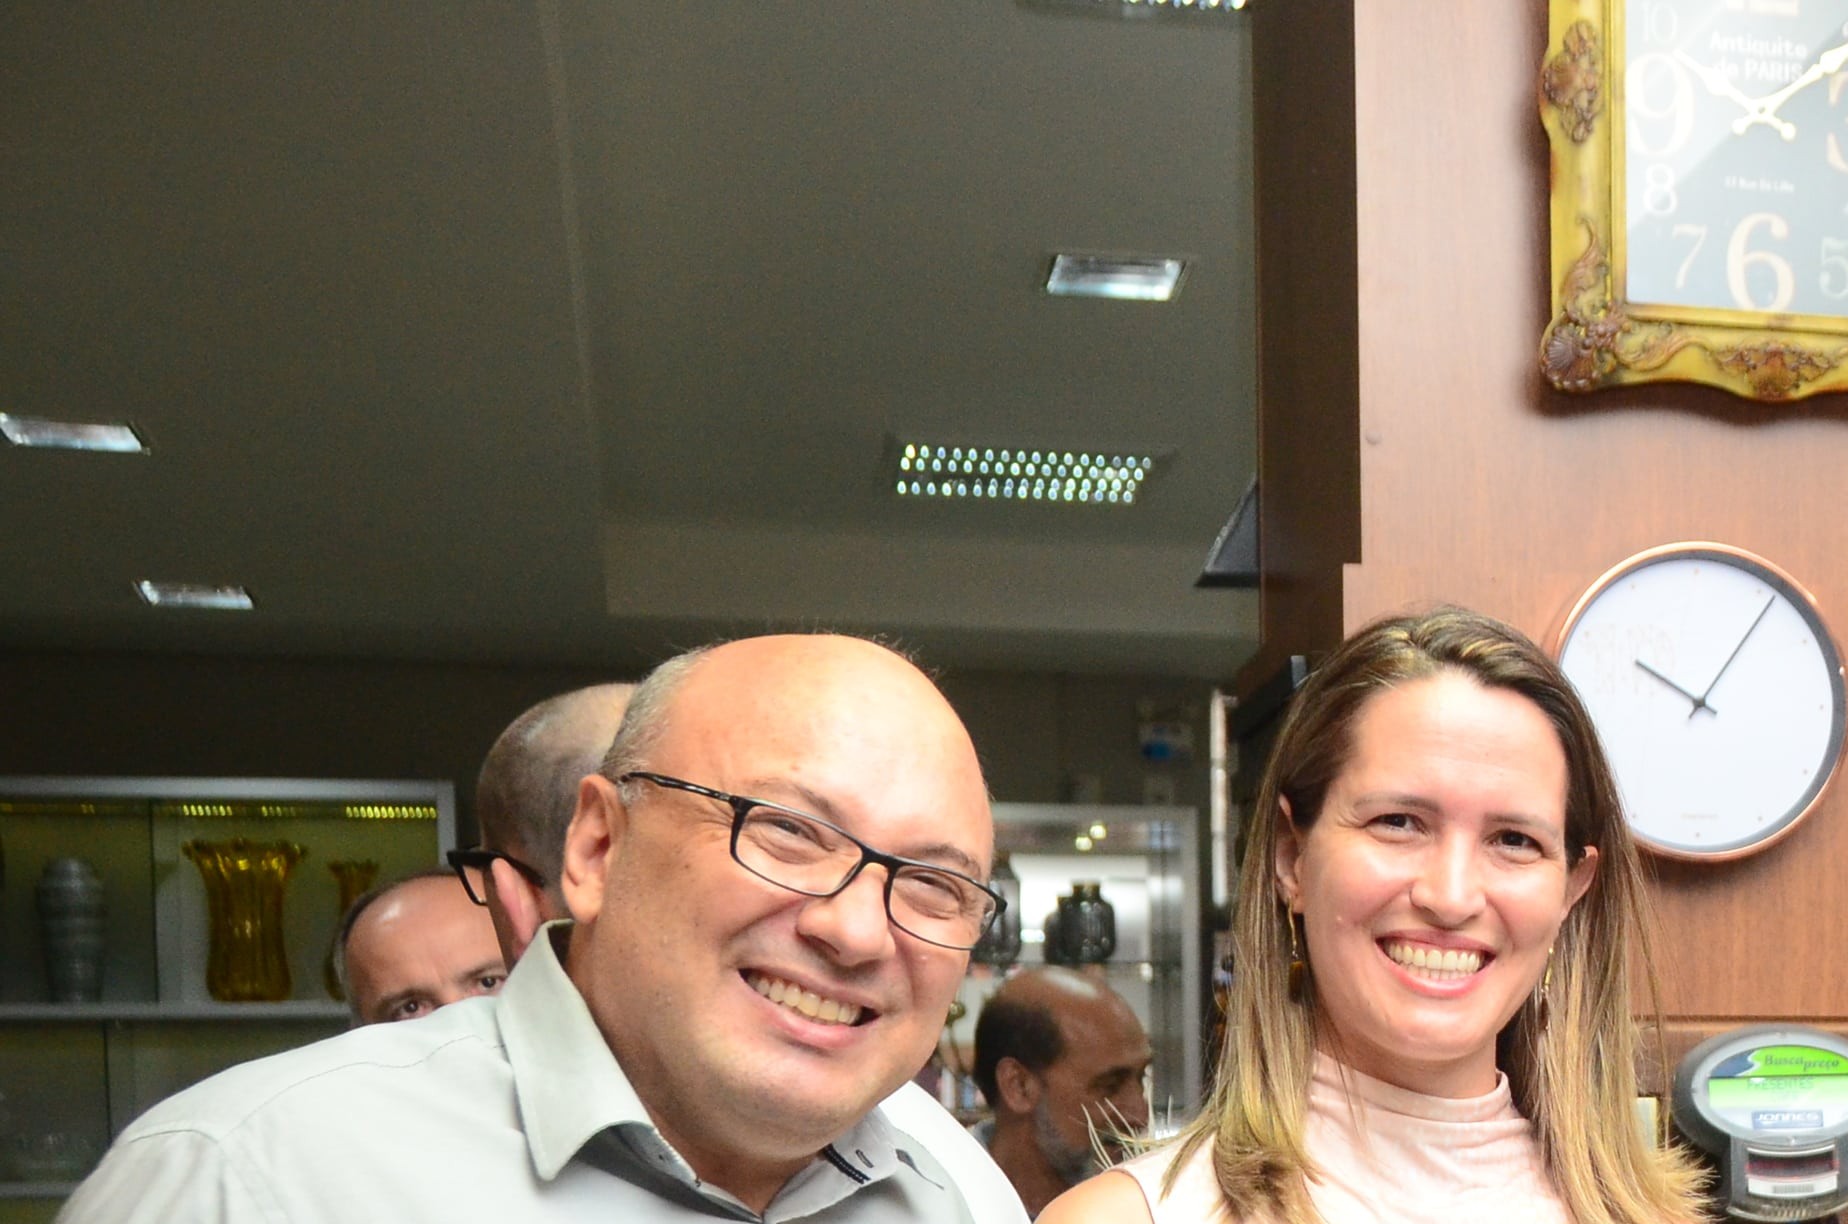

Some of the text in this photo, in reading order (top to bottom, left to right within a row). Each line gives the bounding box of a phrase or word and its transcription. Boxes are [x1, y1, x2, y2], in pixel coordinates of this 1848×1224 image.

[1624, 52, 1695, 157] 9
[1643, 164, 1678, 216] 8
[1671, 224, 1707, 290] 7
[1726, 212, 1795, 312] 6
